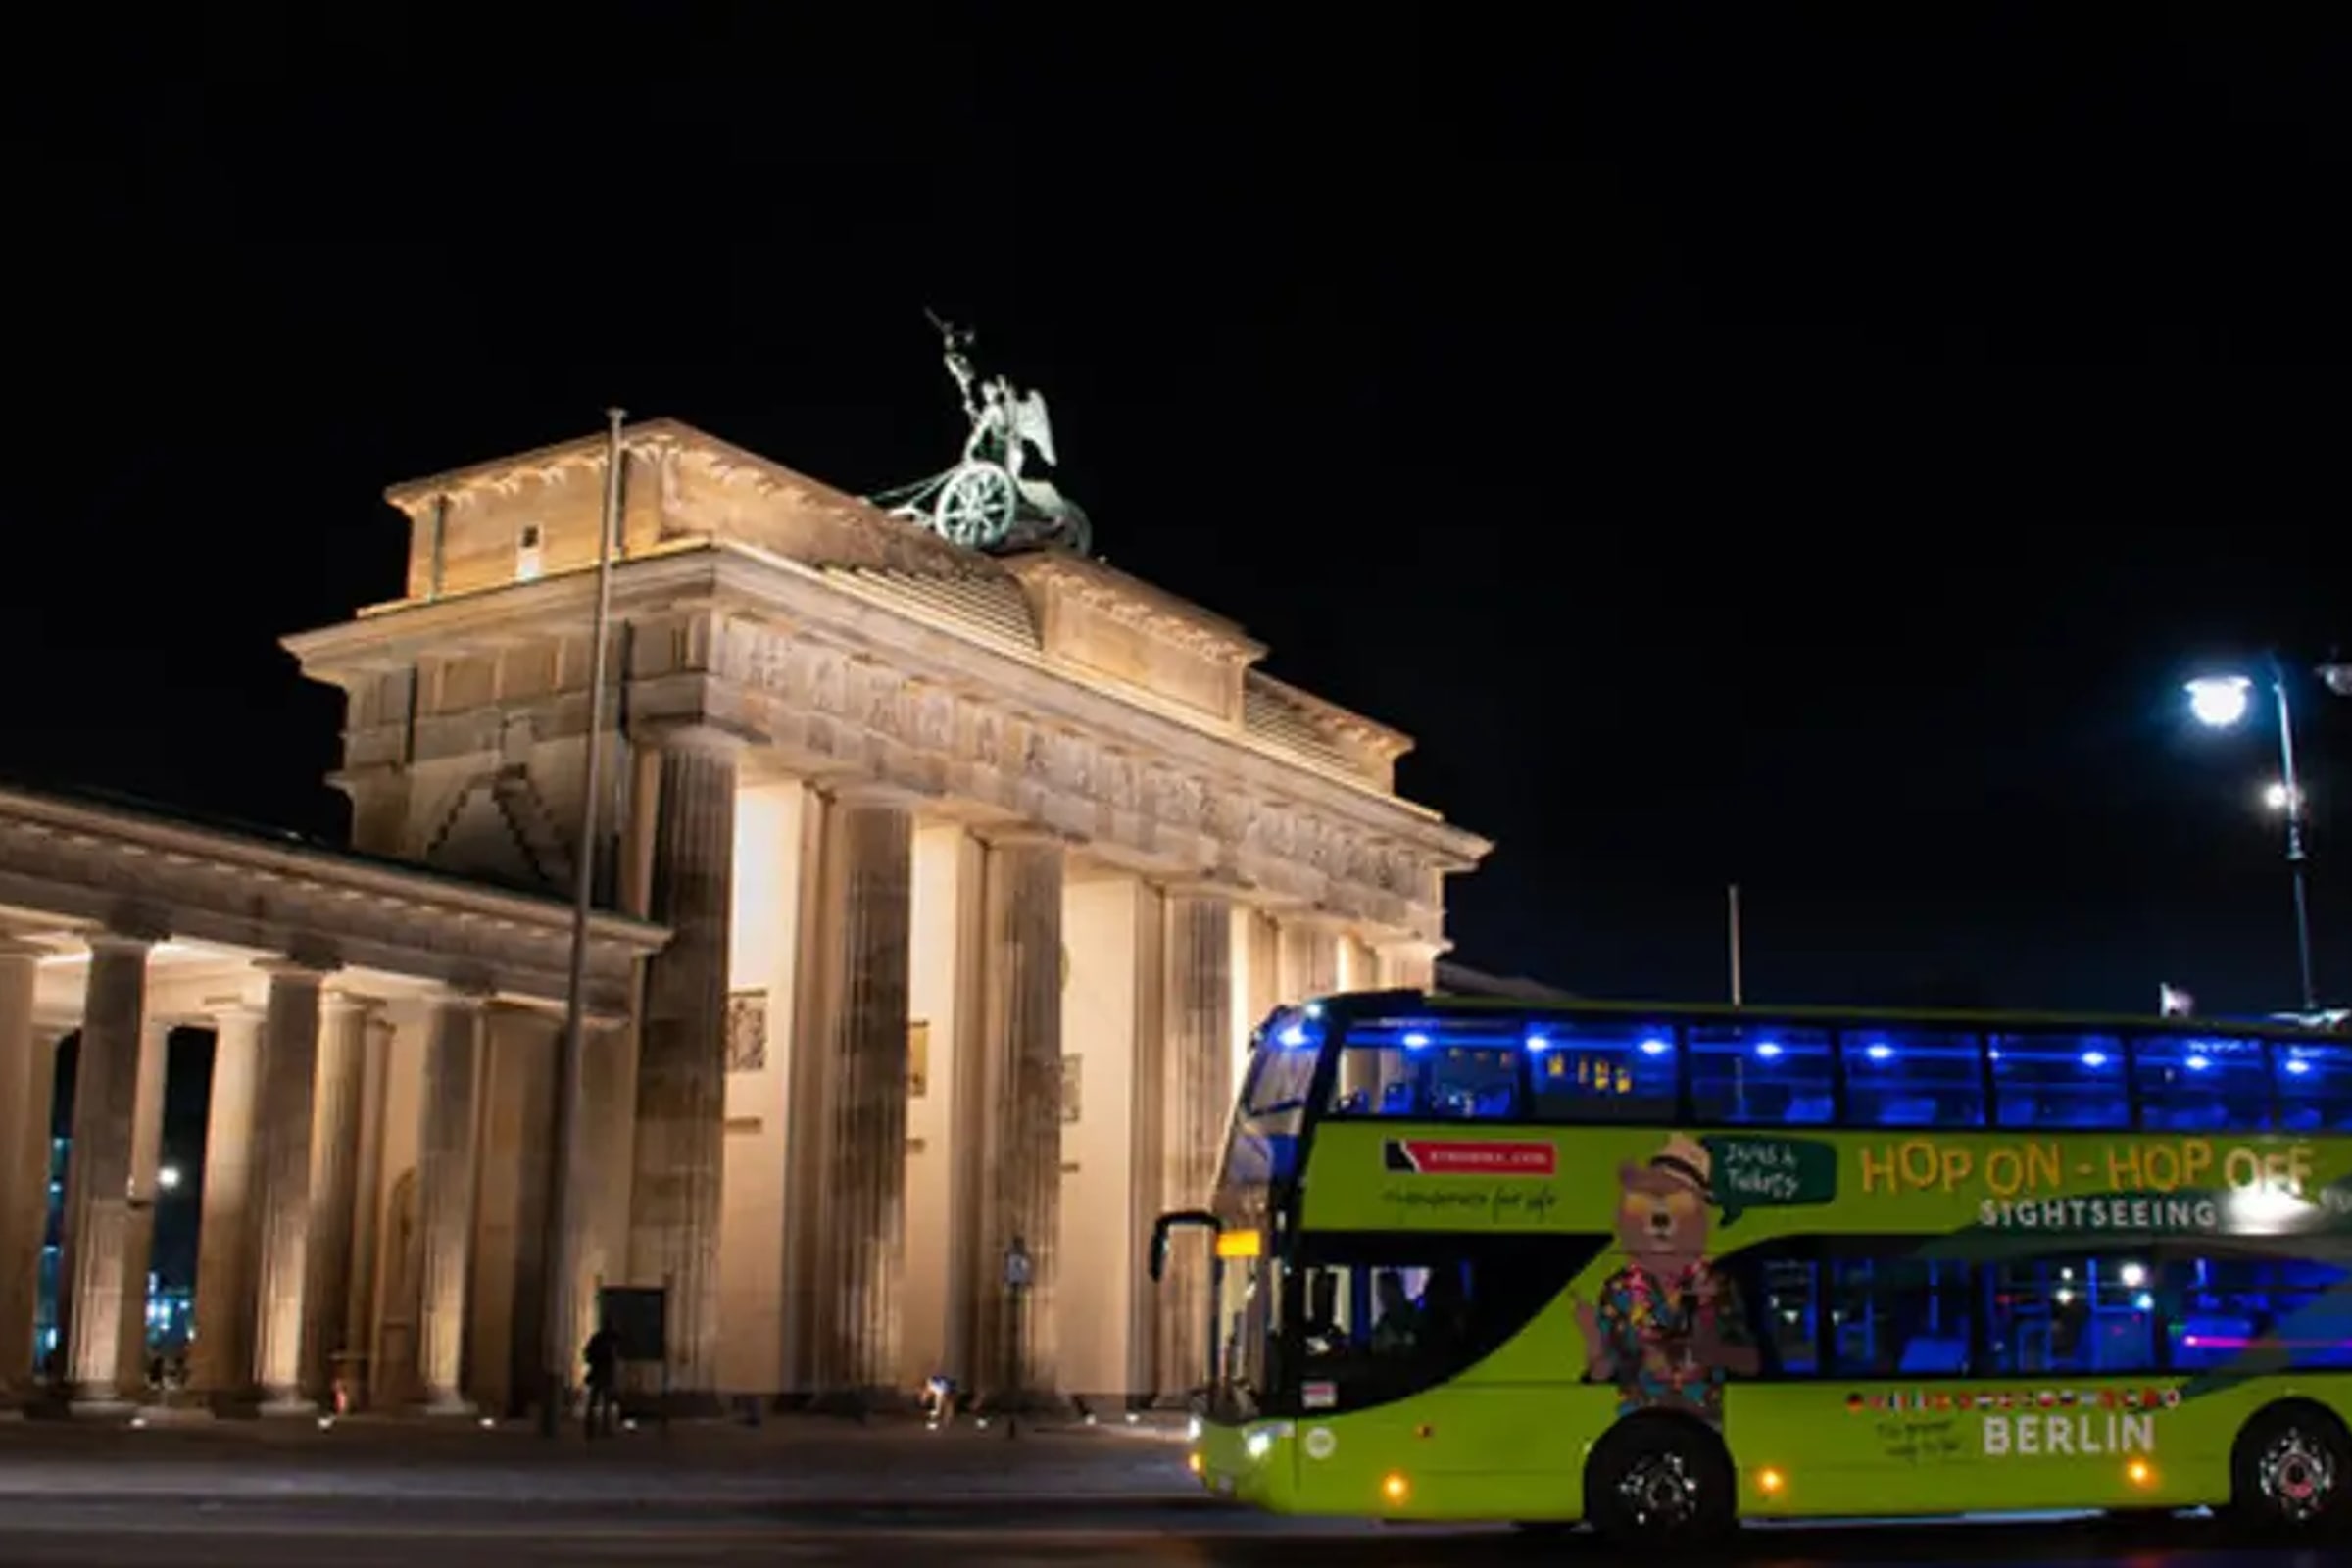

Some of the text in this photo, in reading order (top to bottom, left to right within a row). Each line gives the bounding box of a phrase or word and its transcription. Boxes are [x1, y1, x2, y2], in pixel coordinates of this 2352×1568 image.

[1860, 1139, 1973, 1194] HOP
[1985, 1141, 2063, 1197] ON
[2108, 1138, 2213, 1193] HOP
[2224, 1145, 2315, 1196] OFF
[1979, 1198, 2217, 1227] SIGHTSEEING
[1983, 1415, 2155, 1455] BERLIN
